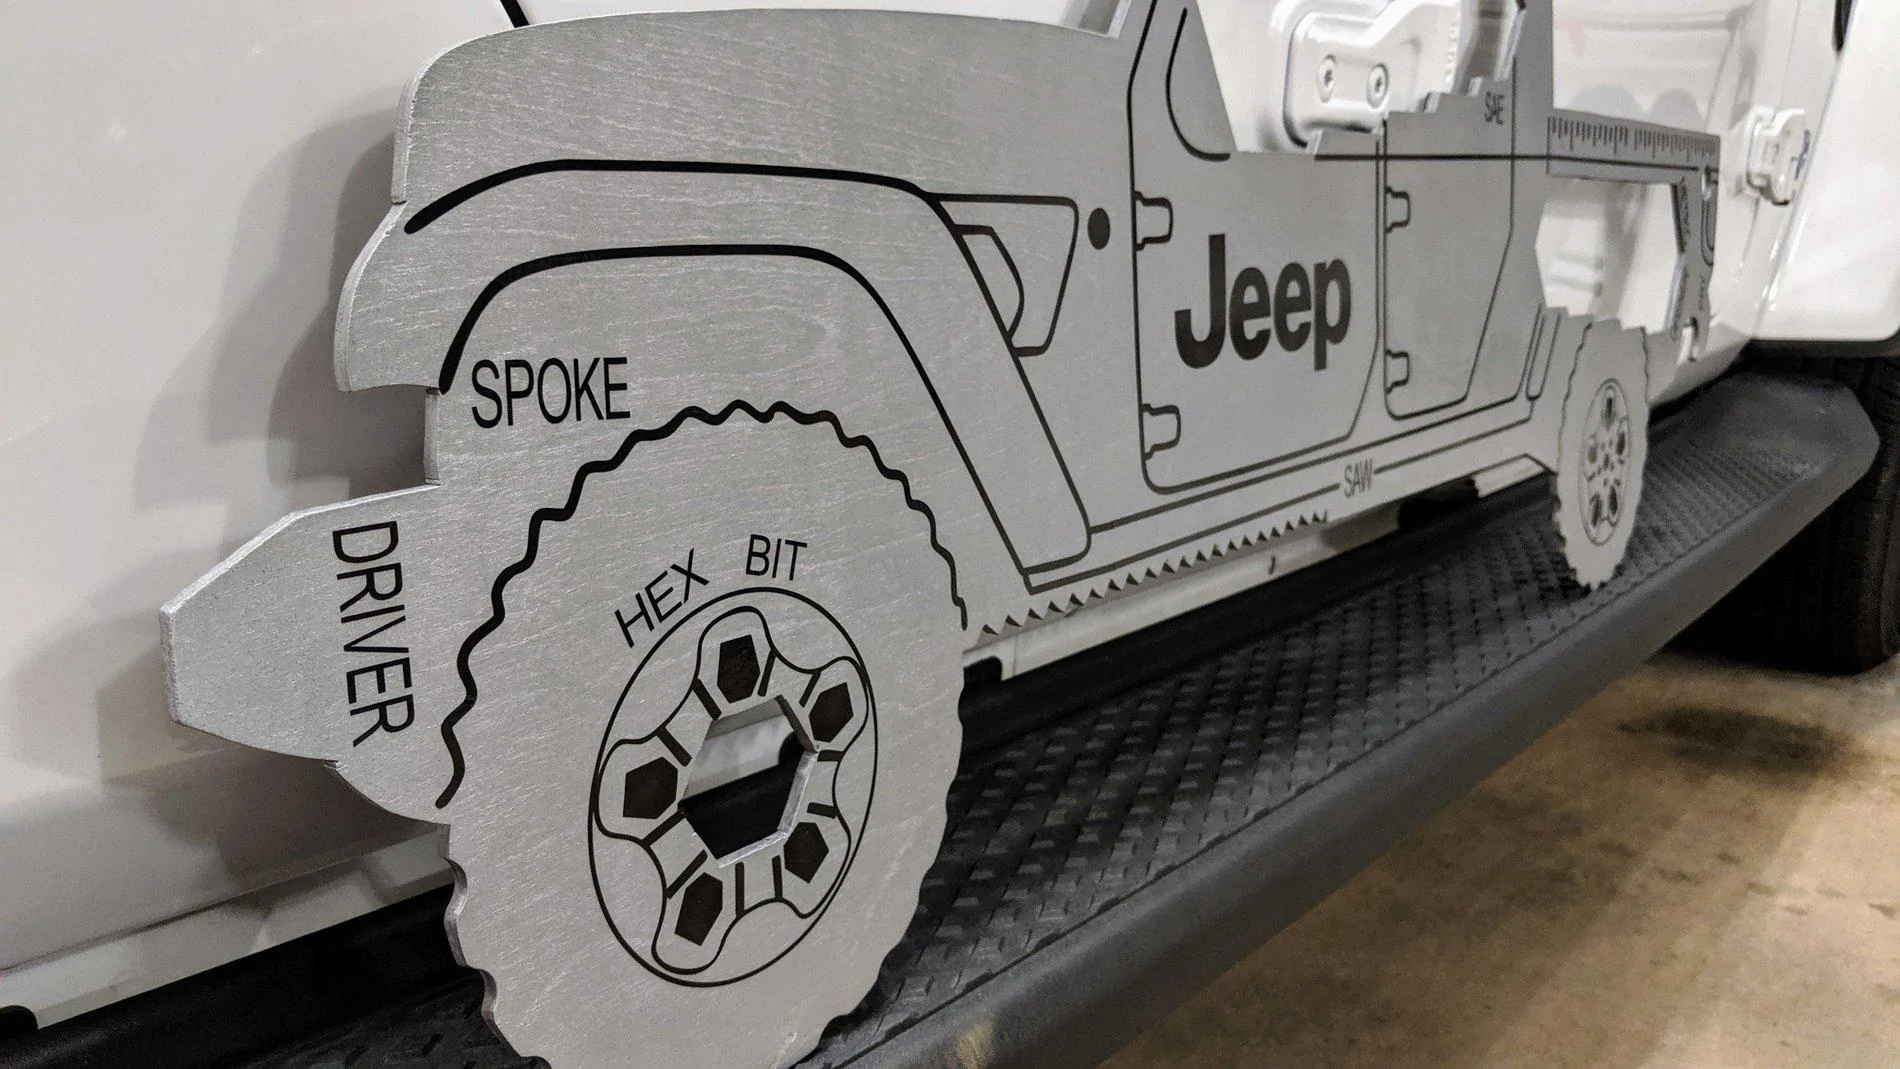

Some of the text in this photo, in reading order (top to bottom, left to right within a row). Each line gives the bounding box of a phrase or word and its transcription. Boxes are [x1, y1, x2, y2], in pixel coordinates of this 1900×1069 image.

[1484, 91, 1504, 125] SAE
[1175, 234, 1351, 371] Jeep
[472, 357, 630, 428] SPOKE
[1344, 458, 1373, 498] SAW
[333, 521, 414, 747] DRIVER
[614, 534, 807, 648] HEX BIT
